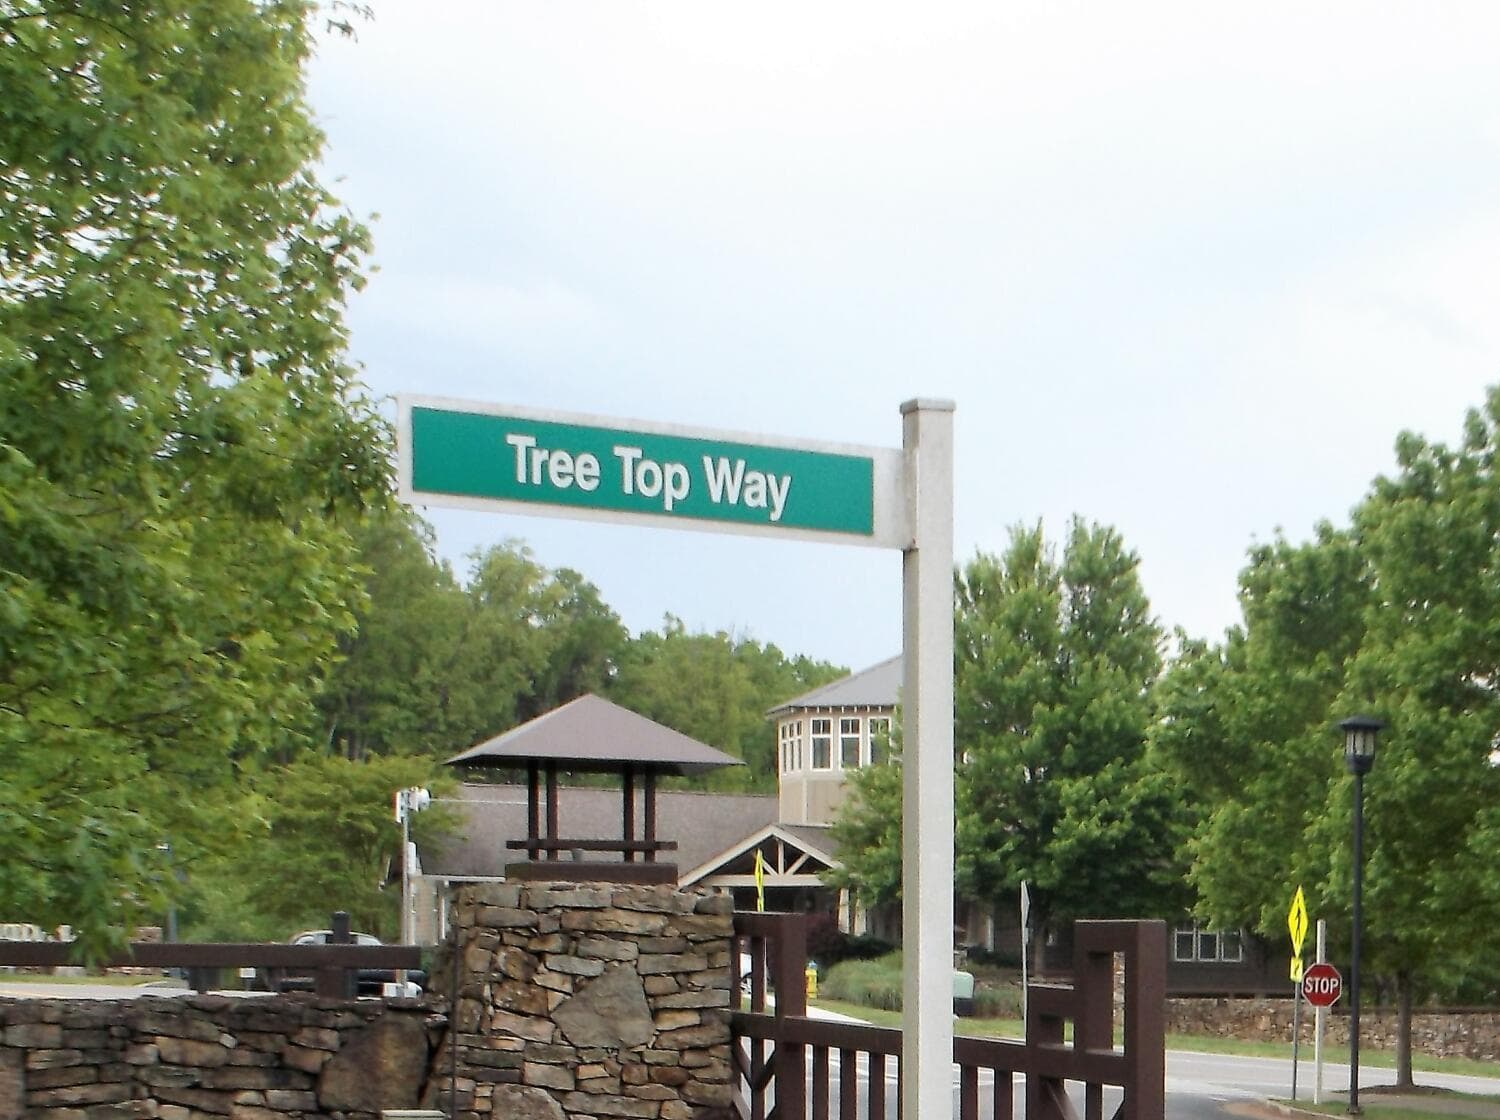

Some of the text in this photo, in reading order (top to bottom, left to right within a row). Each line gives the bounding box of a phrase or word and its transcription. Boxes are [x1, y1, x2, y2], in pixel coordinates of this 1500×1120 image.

[506, 433, 792, 521] Tree Top Way
[1304, 977, 1339, 993] STOP
